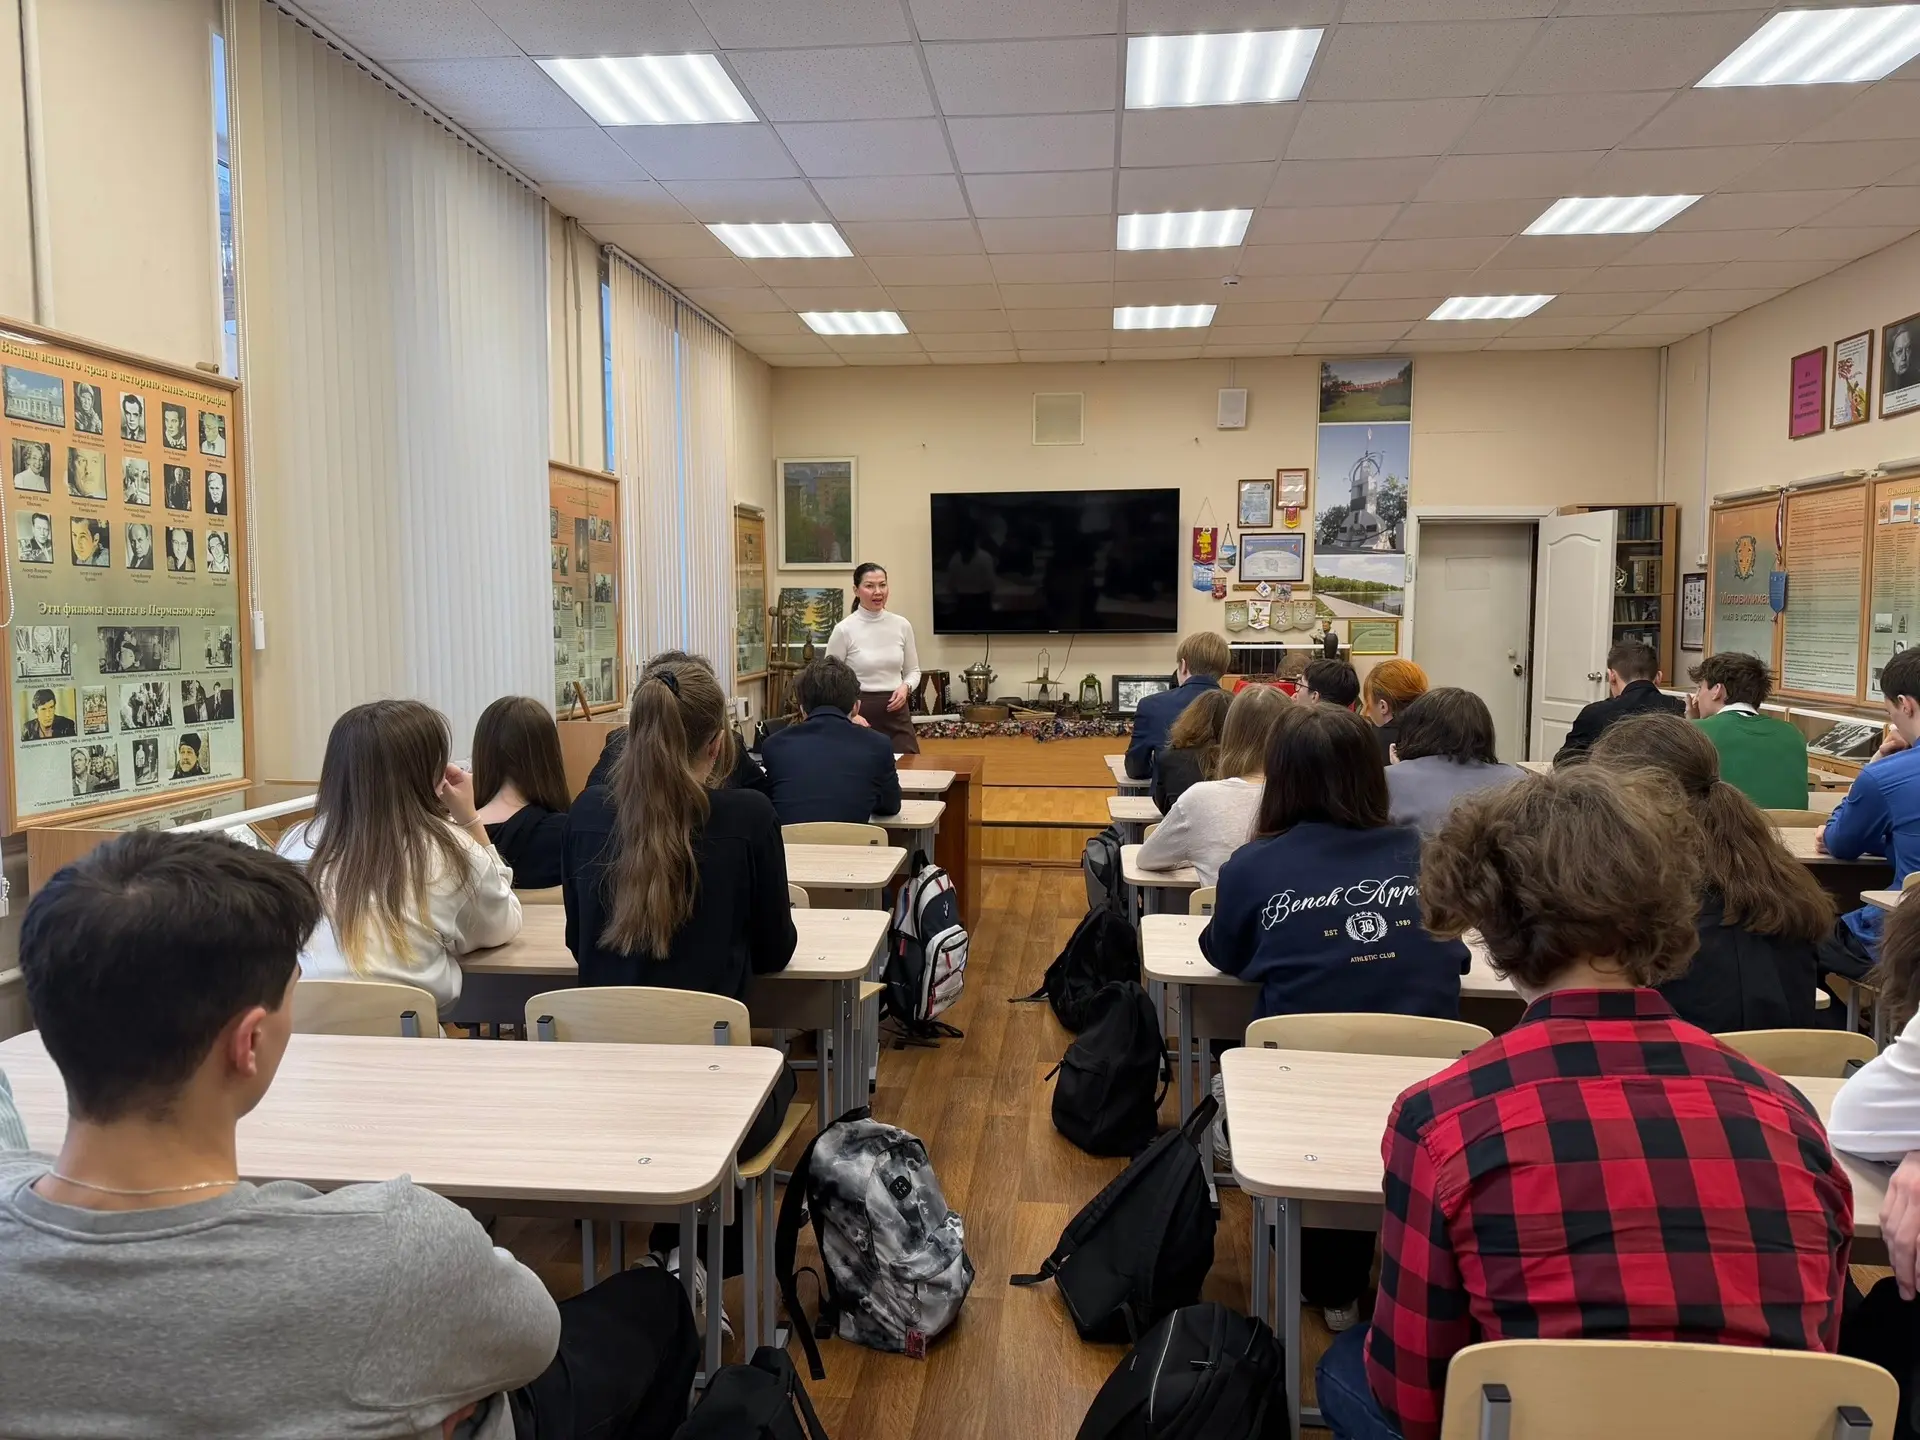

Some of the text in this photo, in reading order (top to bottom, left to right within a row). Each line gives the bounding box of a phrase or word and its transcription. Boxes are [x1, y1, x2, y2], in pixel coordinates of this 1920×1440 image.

[42, 353, 82, 371] нашего
[84, 363, 108, 377] края
[120, 373, 160, 389] историю
[161, 383, 227, 408] кинематографа
[38, 601, 216, 619] Эти фильмы сняты в Пермском крае
[1261, 886, 1344, 931] Bench
[1324, 929, 1339, 938] EST
[1358, 919, 1375, 936] B
[1350, 951, 1396, 963] ATHLETIC CLUB
